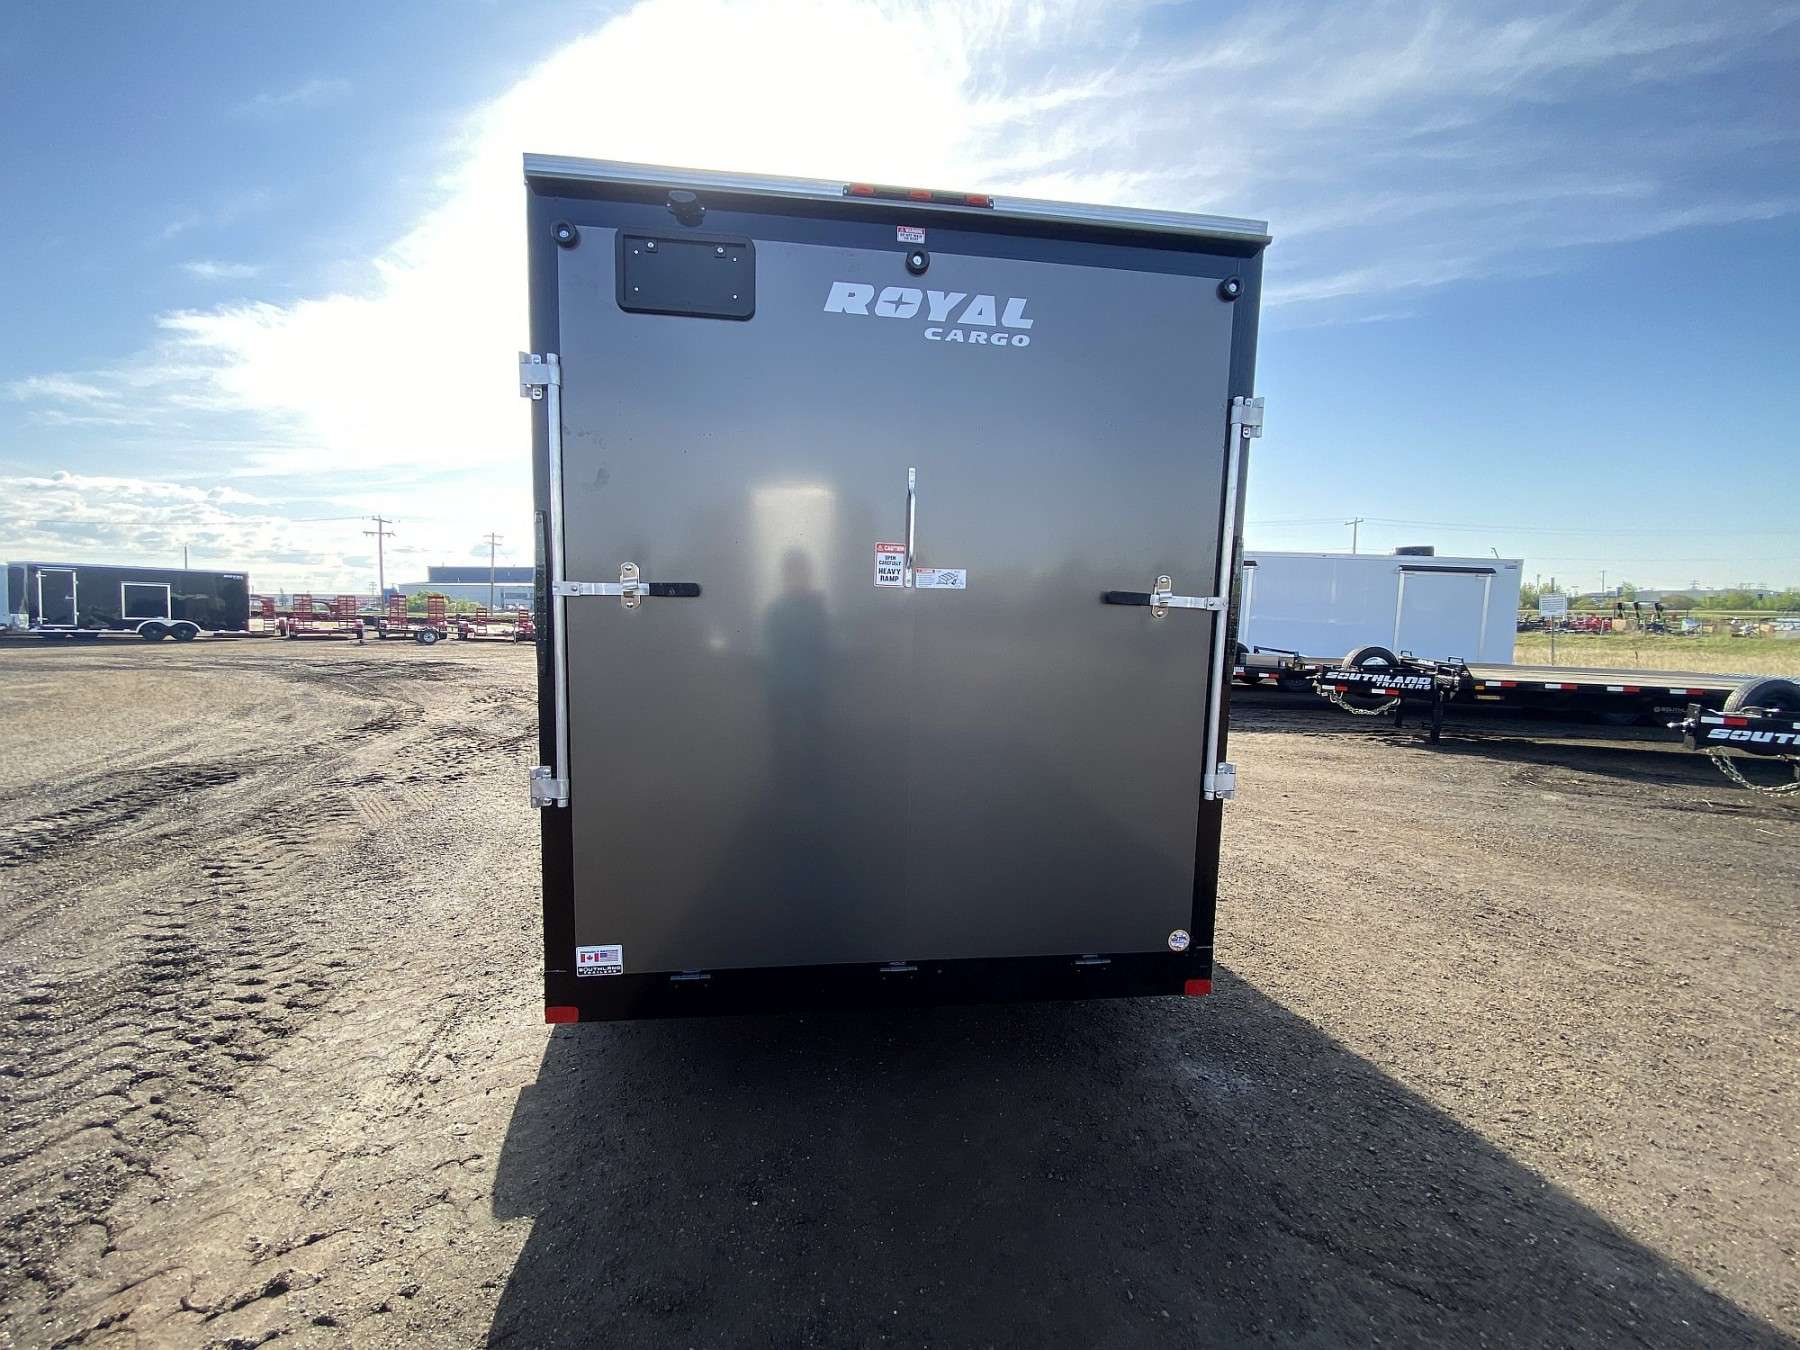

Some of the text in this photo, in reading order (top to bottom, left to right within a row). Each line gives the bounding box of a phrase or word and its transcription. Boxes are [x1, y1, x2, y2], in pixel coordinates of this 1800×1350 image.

[823, 281, 1034, 328] ROYAL
[924, 327, 1031, 347] CARGO
[1325, 671, 1431, 685] SOUTHLAND
[1375, 680, 1431, 690] TRAILERS
